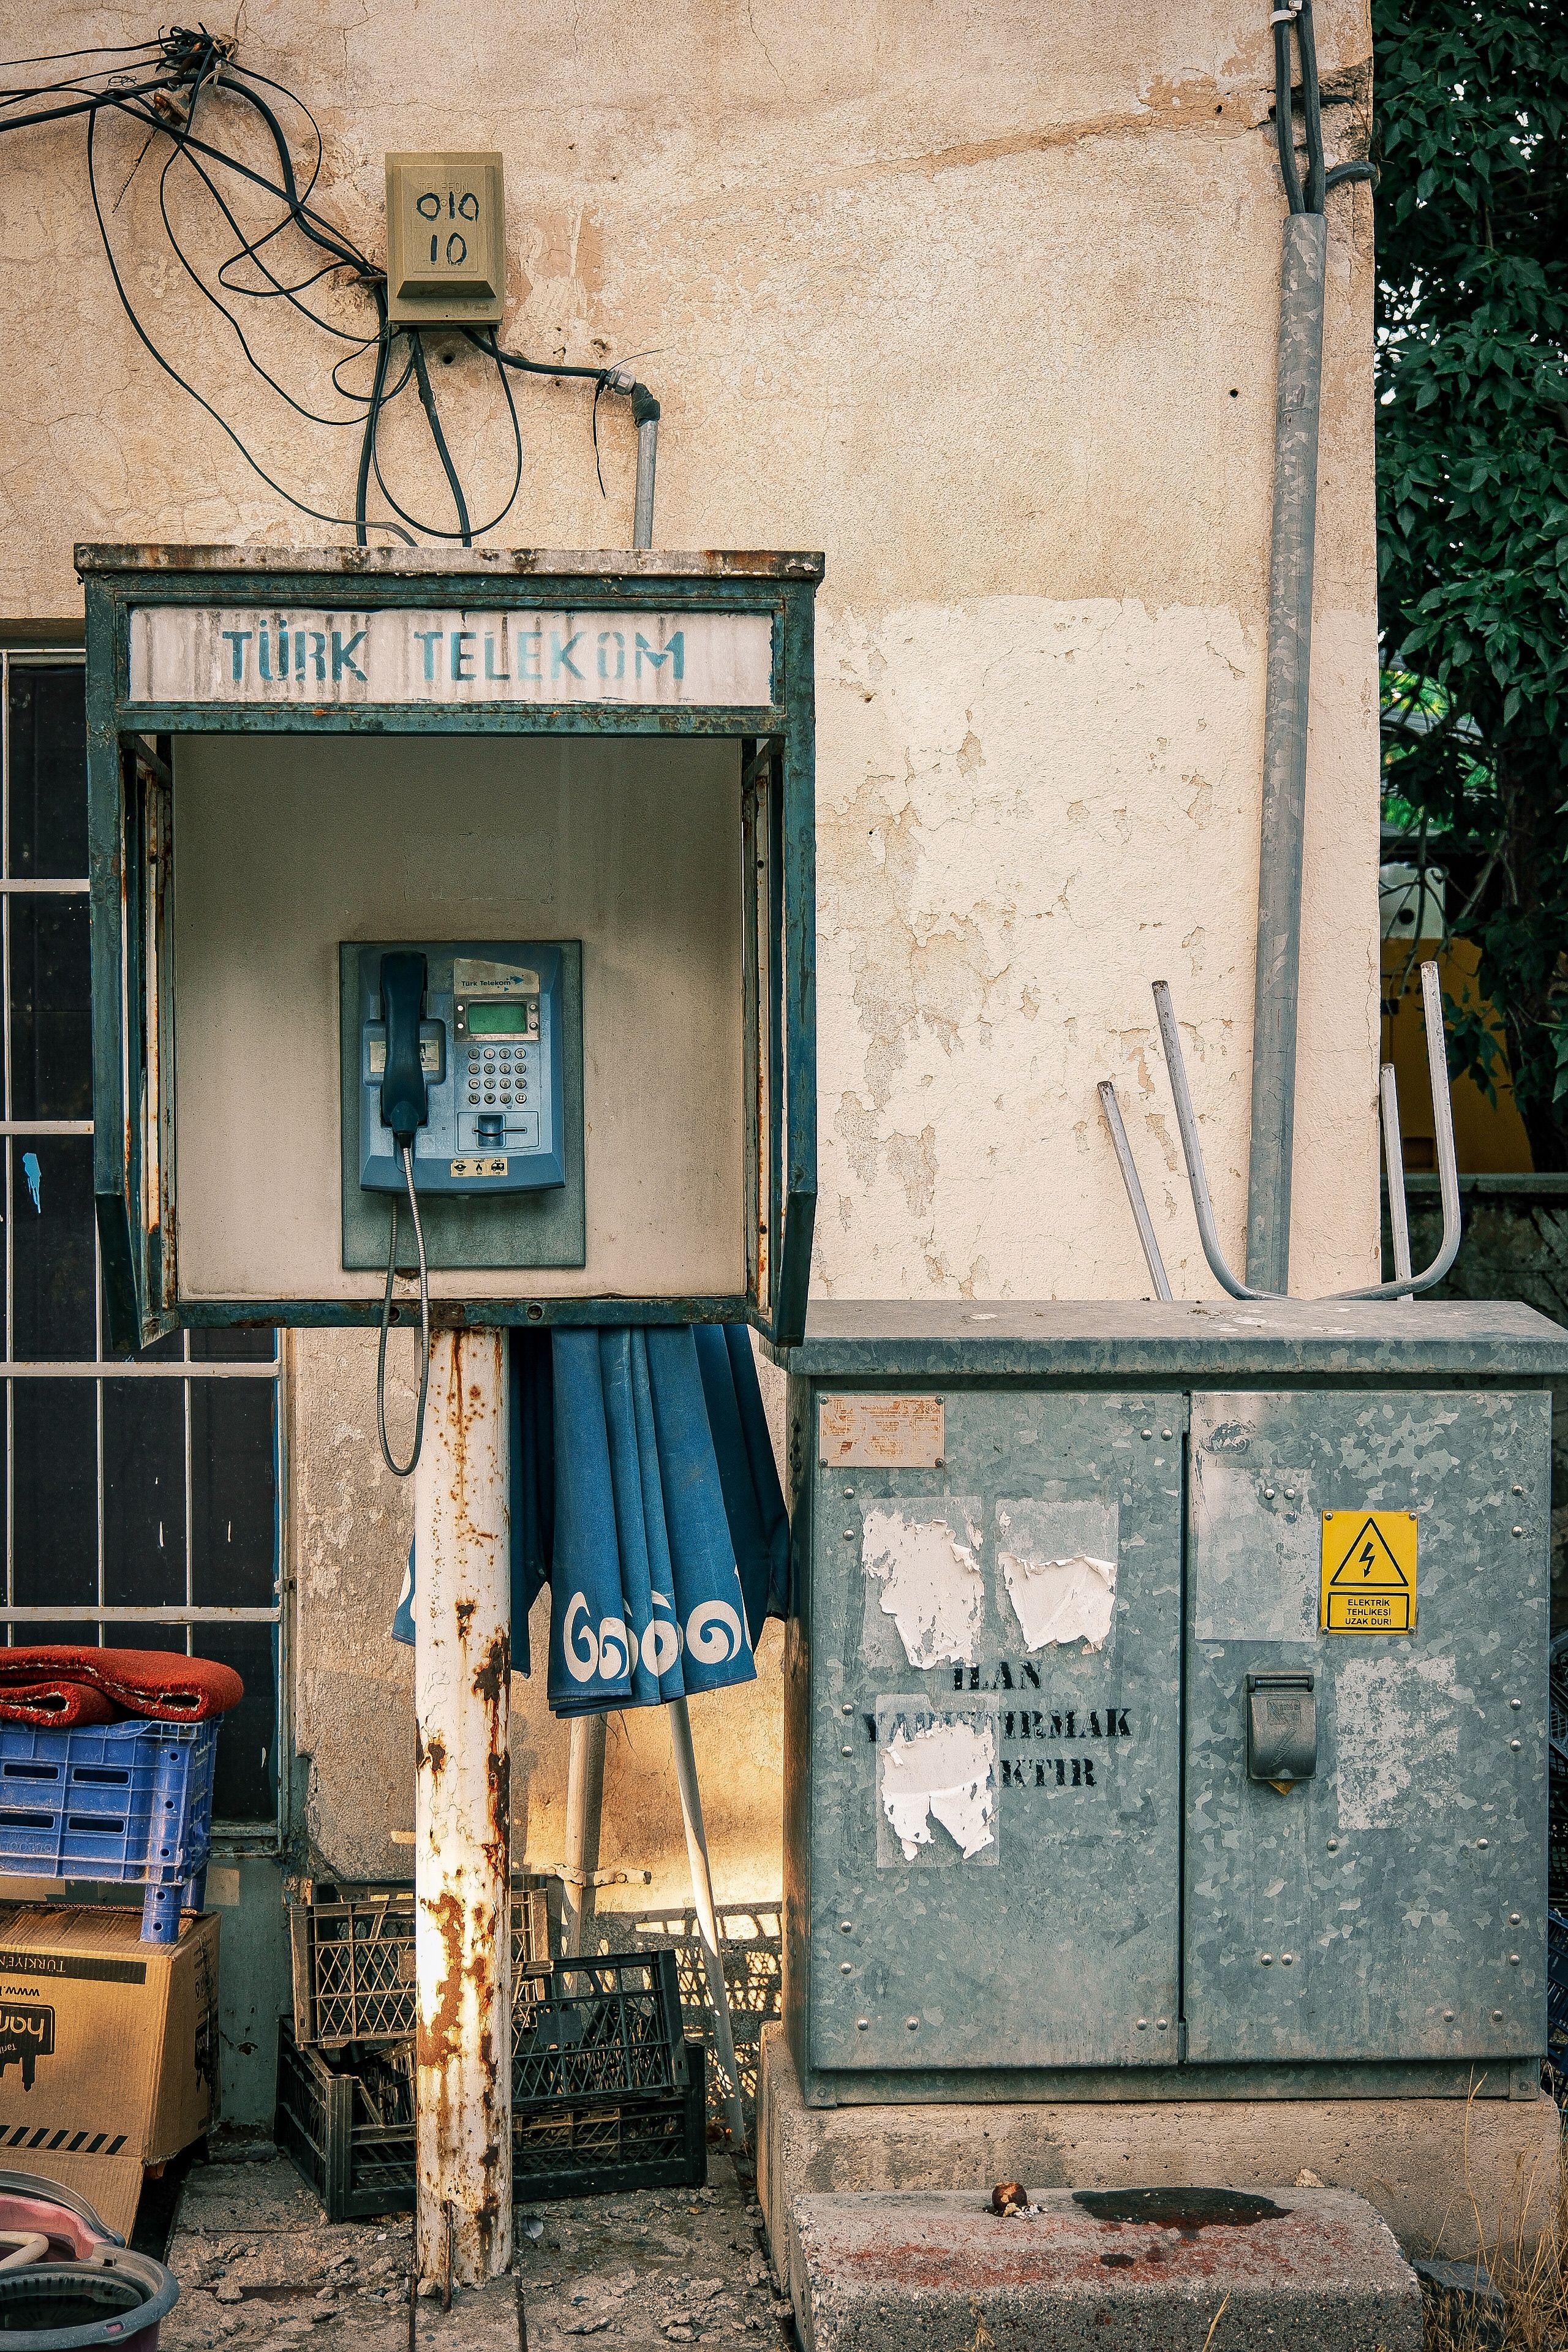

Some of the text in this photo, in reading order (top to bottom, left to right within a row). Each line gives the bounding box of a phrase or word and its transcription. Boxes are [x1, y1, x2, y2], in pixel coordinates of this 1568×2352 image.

[418, 181, 469, 194] TELEFON
[430, 232, 467, 265] 10
[222, 619, 684, 681] TÜRK TELEKOM
[1347, 1607, 1390, 1616] TEHLİKESİ
[0, 1986, 40, 1997] www.
[0, 2043, 17, 2054] Tari
